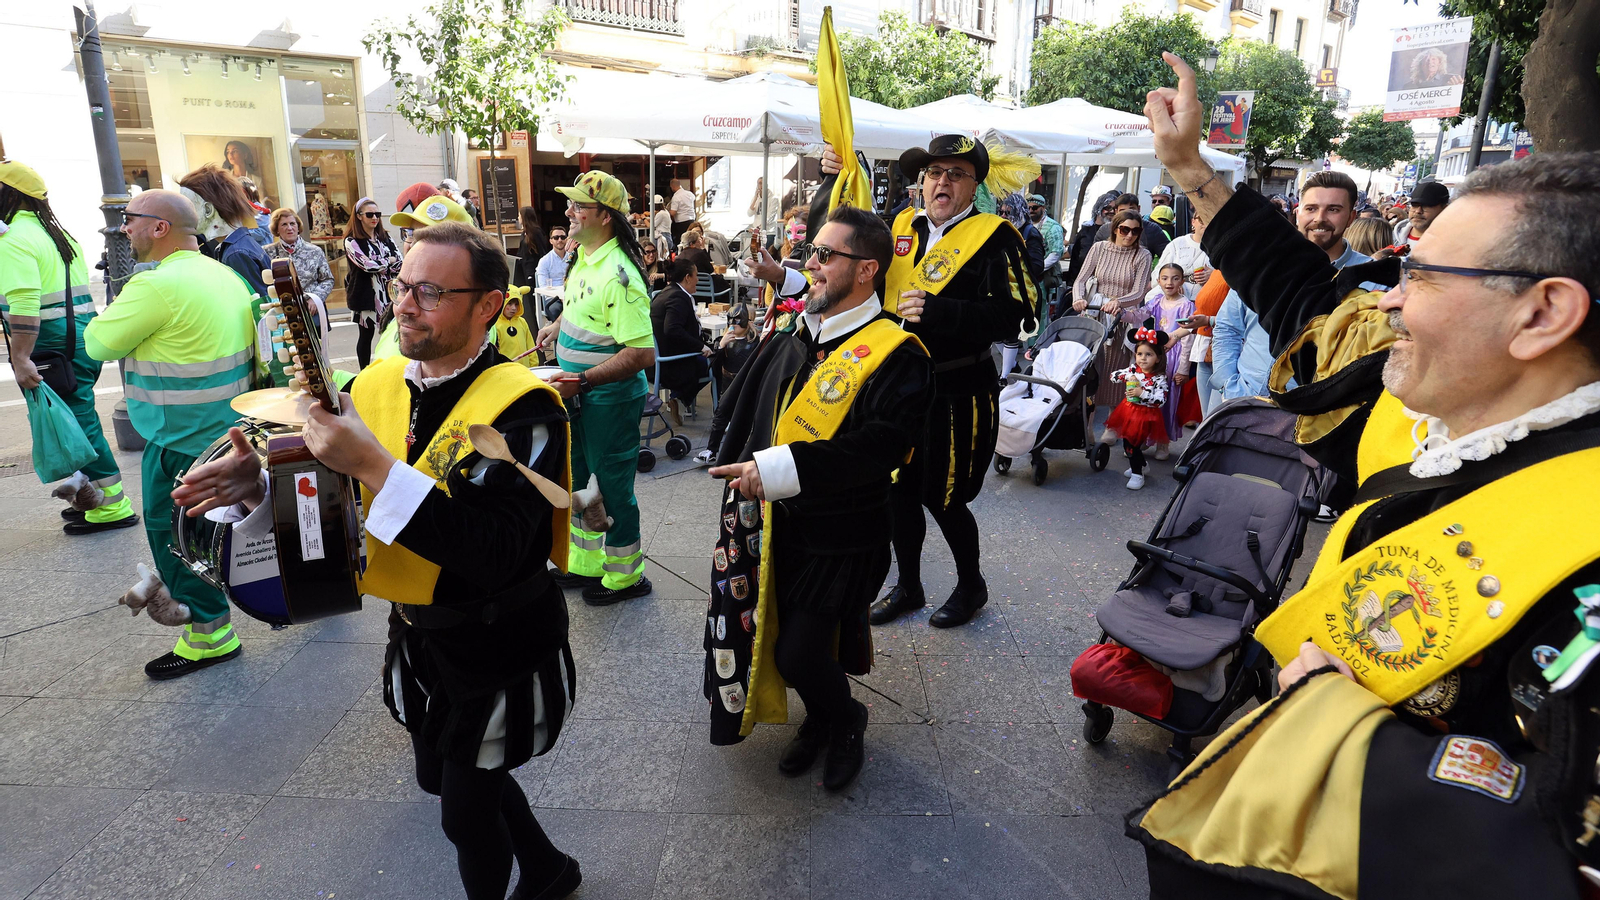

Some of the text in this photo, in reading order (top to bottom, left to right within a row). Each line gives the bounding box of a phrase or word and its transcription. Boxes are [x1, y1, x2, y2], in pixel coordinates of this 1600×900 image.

[1412, 28, 1465, 39] FESTIVAL
[1434, 22, 1456, 30] PEPE
[1397, 87, 1452, 102] JOSÉ MERCÉ
[182, 97, 256, 109] PUNT ROMA
[1214, 105, 1225, 113] 28
[702, 114, 752, 130] Cruzcampo
[821, 361, 837, 369] TUNA
[847, 366, 859, 392] MEDICINA
[806, 398, 829, 417] BADAJOZ
[1375, 545, 1460, 662] TUNA DE MEDICINA
[1325, 612, 1371, 678] BADAJOZ
[1442, 768, 1504, 794] ESPAÑA
